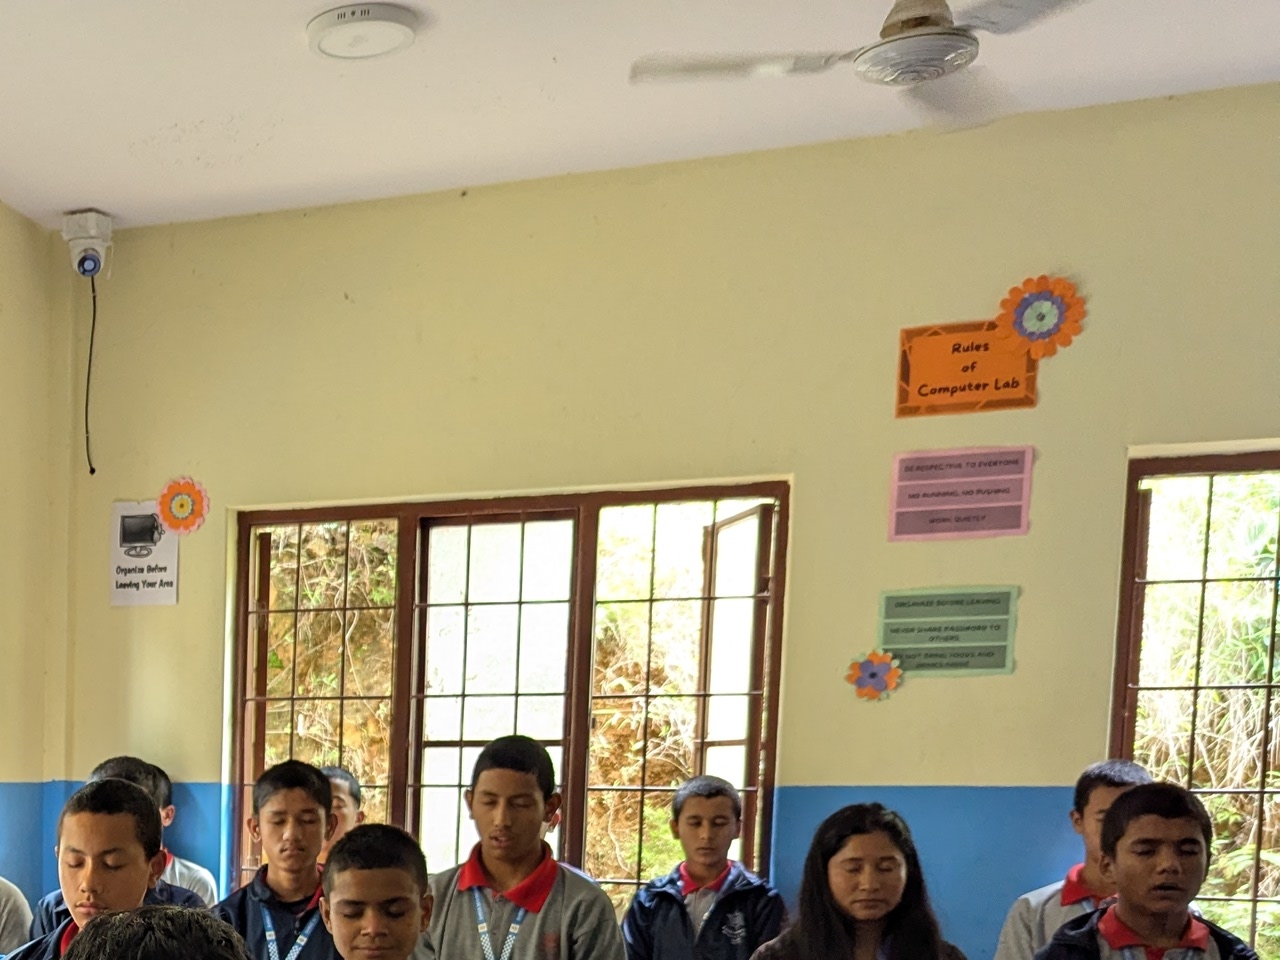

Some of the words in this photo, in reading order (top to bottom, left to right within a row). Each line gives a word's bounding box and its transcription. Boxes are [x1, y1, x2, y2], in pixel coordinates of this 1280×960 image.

[951, 341, 990, 355] Rules
[961, 361, 977, 374] of
[918, 379, 989, 397] Computer
[994, 377, 1020, 391] Lab
[116, 565, 144, 577] Organize
[147, 564, 167, 574] Before
[115, 580, 140, 591] Leaving
[142, 580, 157, 589] Your
[159, 579, 173, 588] Area
